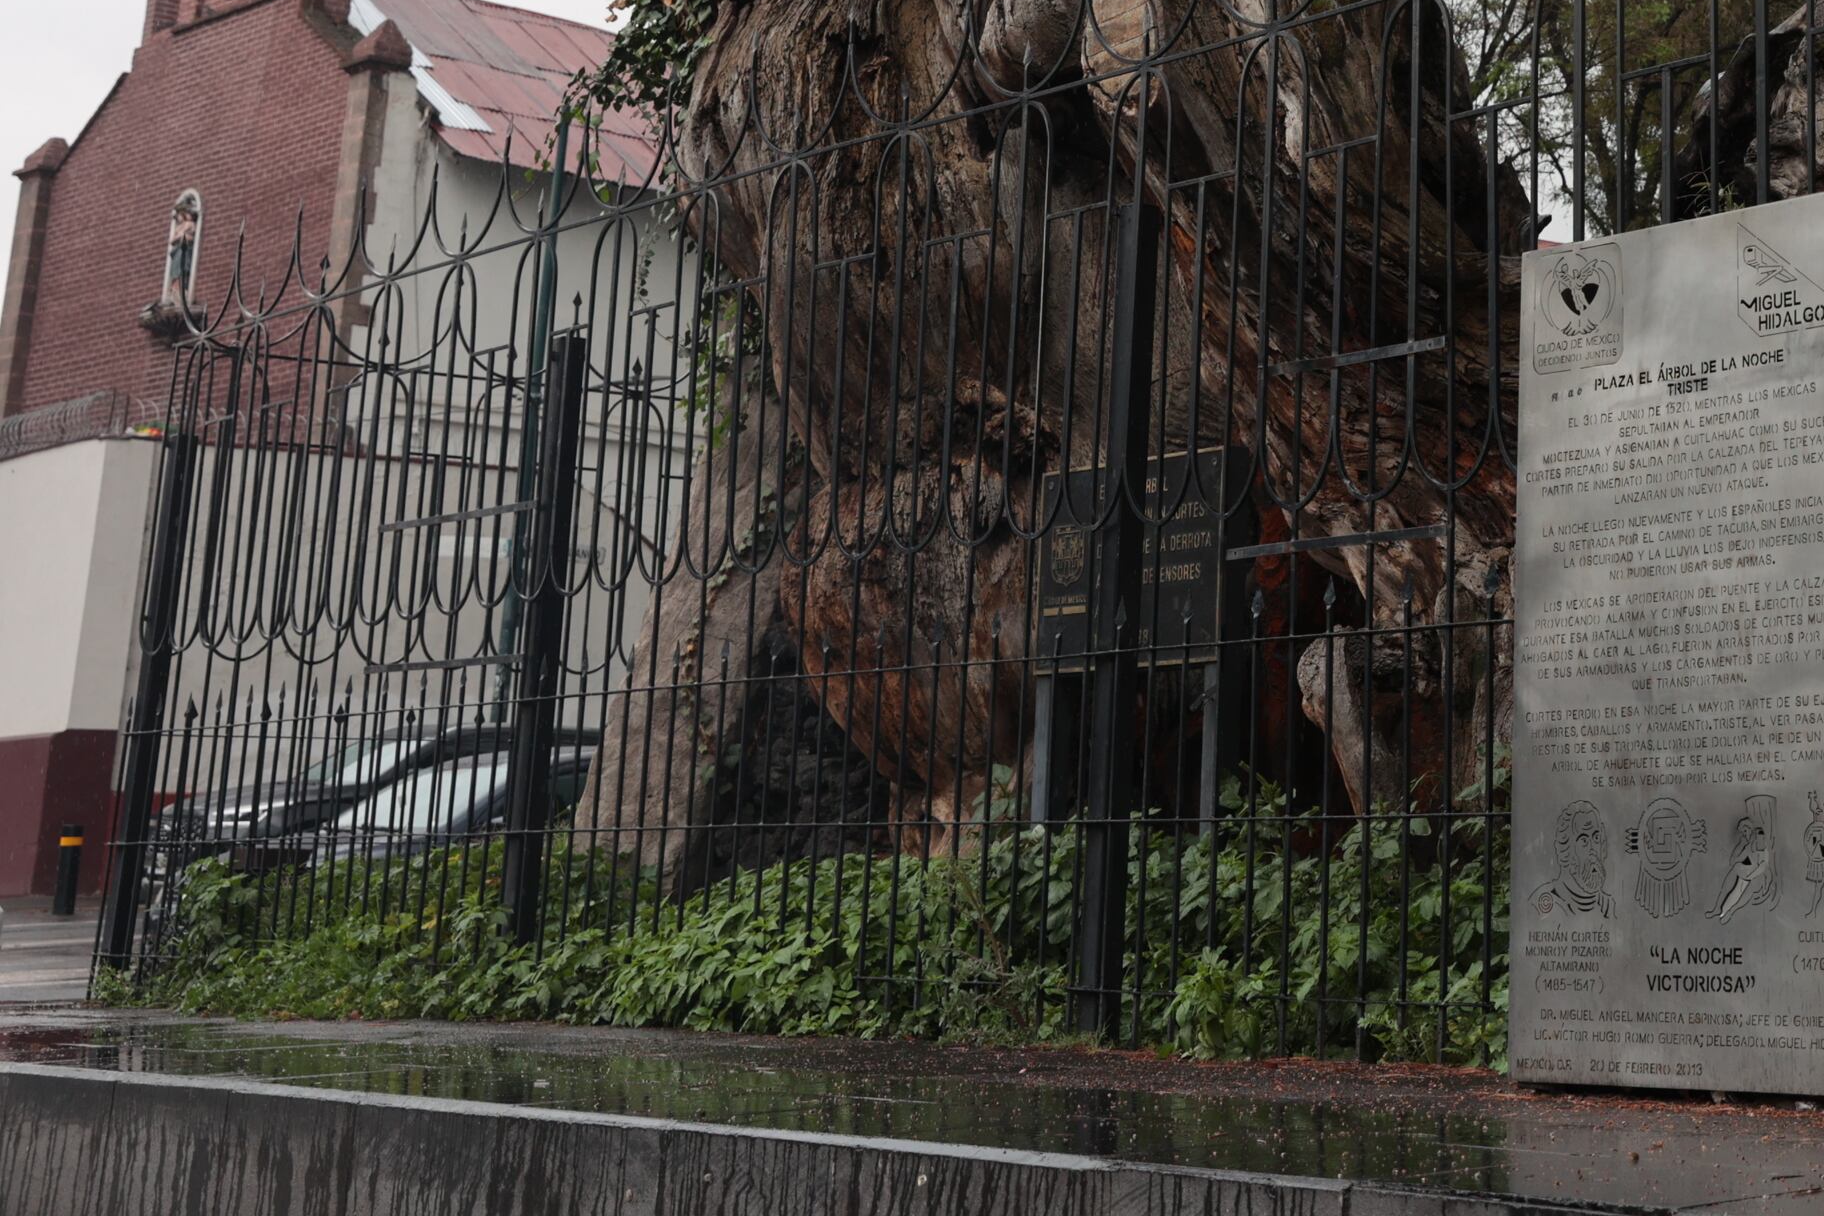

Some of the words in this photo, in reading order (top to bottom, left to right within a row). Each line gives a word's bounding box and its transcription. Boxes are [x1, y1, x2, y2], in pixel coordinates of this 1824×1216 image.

[1739, 287, 1802, 316] MIGUEL
[1535, 338, 1569, 357] CIUDAD
[1569, 336, 1583, 351] DE
[1585, 329, 1620, 349] MEXICO
[1593, 371, 1635, 393] PLAZA
[1638, 368, 1653, 386] EL
[1656, 355, 1697, 383] ÁRBOL
[1699, 358, 1717, 376] DE
[1720, 355, 1737, 373] LA
[1741, 347, 1785, 370] NOCHE
[1666, 376, 1709, 397] TRISTE
[1567, 415, 1579, 429] EL
[1582, 412, 1598, 427] 30
[1599, 410, 1613, 425] DE
[1616, 405, 1645, 422] JUNIO
[1647, 403, 1661, 418] DE
[1694, 391, 1743, 411] MIENTRAS
[1747, 387, 1769, 403] LOS
[1771, 380, 1817, 400] MEXICAS
[1617, 417, 1680, 439] SEPULTABAN
[1682, 415, 1695, 430] AL
[1698, 406, 1760, 428] EMPERADOR
[1541, 445, 1601, 465] MOCTEZUMA
[1682, 425, 1745, 446] CUITLAHUAC
[1748, 420, 1779, 438] COMO
[1781, 418, 1797, 433] SU
[1524, 467, 1562, 484] CORTES
[1563, 460, 1609, 479] PREPARO
[1611, 458, 1626, 473] SU
[1628, 453, 1664, 470] SALIDA
[1666, 450, 1687, 465] POR
[1690, 448, 1704, 462] LA
[1706, 441, 1755, 460] CALZADA
[1758, 438, 1779, 453] DEL
[1540, 482, 1574, 498] PARTIR
[1576, 480, 1590, 494] DE
[1592, 473, 1643, 492] INMEDIATO
[1644, 470, 1662, 485] DIO
[1665, 461, 1737, 483] OPORTUNIDAD
[1751, 456, 1773, 472] QUE
[1776, 453, 1798, 469] LOS
[1613, 487, 1667, 506] LANZARAN
[1669, 485, 1685, 499] UN
[1687, 480, 1722, 497] NUEVO
[1541, 525, 1555, 539] LA
[1557, 521, 1589, 537] NOCHE
[1591, 517, 1625, 533] LLEGO
[1627, 509, 1693, 529] NUEVAMENTE
[1706, 505, 1728, 520] LOS
[1730, 494, 1792, 517] ESPAÑOLES
[1170, 531, 1212, 552] DERROTA
[1551, 540, 1566, 554] SU
[1568, 534, 1616, 552] RETIRADA
[1617, 532, 1639, 547] POR
[1641, 530, 1655, 544] EL
[1657, 525, 1695, 543] CAMINO
[1698, 523, 1712, 538] DE
[1759, 516, 1777, 532] SIN
[1562, 556, 1576, 570] LA
[1578, 550, 1634, 568] OSCURIDAD
[1647, 547, 1661, 561] LA
[1664, 543, 1700, 559] LLUVIA
[1702, 540, 1724, 555] LOS
[1143, 563, 1200, 584] DEENSORES
[1608, 568, 1623, 582] NO
[1626, 562, 1677, 580] PUDIERON
[1679, 559, 1708, 575] USAR
[1710, 556, 1733, 571] SUS
[1591, 775, 1605, 789] SE
[1638, 772, 1682, 787] VENCIDO
[1685, 771, 1708, 785] POR
[1711, 769, 1734, 784] LOS
[1527, 922, 1568, 943] HERNÁN
[1570, 922, 1610, 943] CORTÉS
[1524, 944, 1568, 957] MONROY
[1570, 945, 1613, 958] PIZARRO
[1687, 946, 1743, 965] NOCHE
[1538, 960, 1600, 973] ALTAMIRANO
[1558, 1008, 1594, 1022] MIGUEL
[1597, 1009, 1633, 1023] ANGEL
[1635, 1010, 1685, 1025] MANCERA
[1744, 1013, 1770, 1027] JEFE
[1773, 1013, 1789, 1027] DE
[1551, 1021, 1589, 1042] VÍCTOR
[1591, 1029, 1621, 1043] HUGO
[1623, 1030, 1654, 1045] ROMO
[1766, 1034, 1807, 1049] MIGUEL
[1588, 1059, 1604, 1073] 20
[1607, 1059, 1621, 1074] DE
[1624, 1060, 1671, 1076] FEBRERO
[1674, 1062, 1703, 1077] 2013
